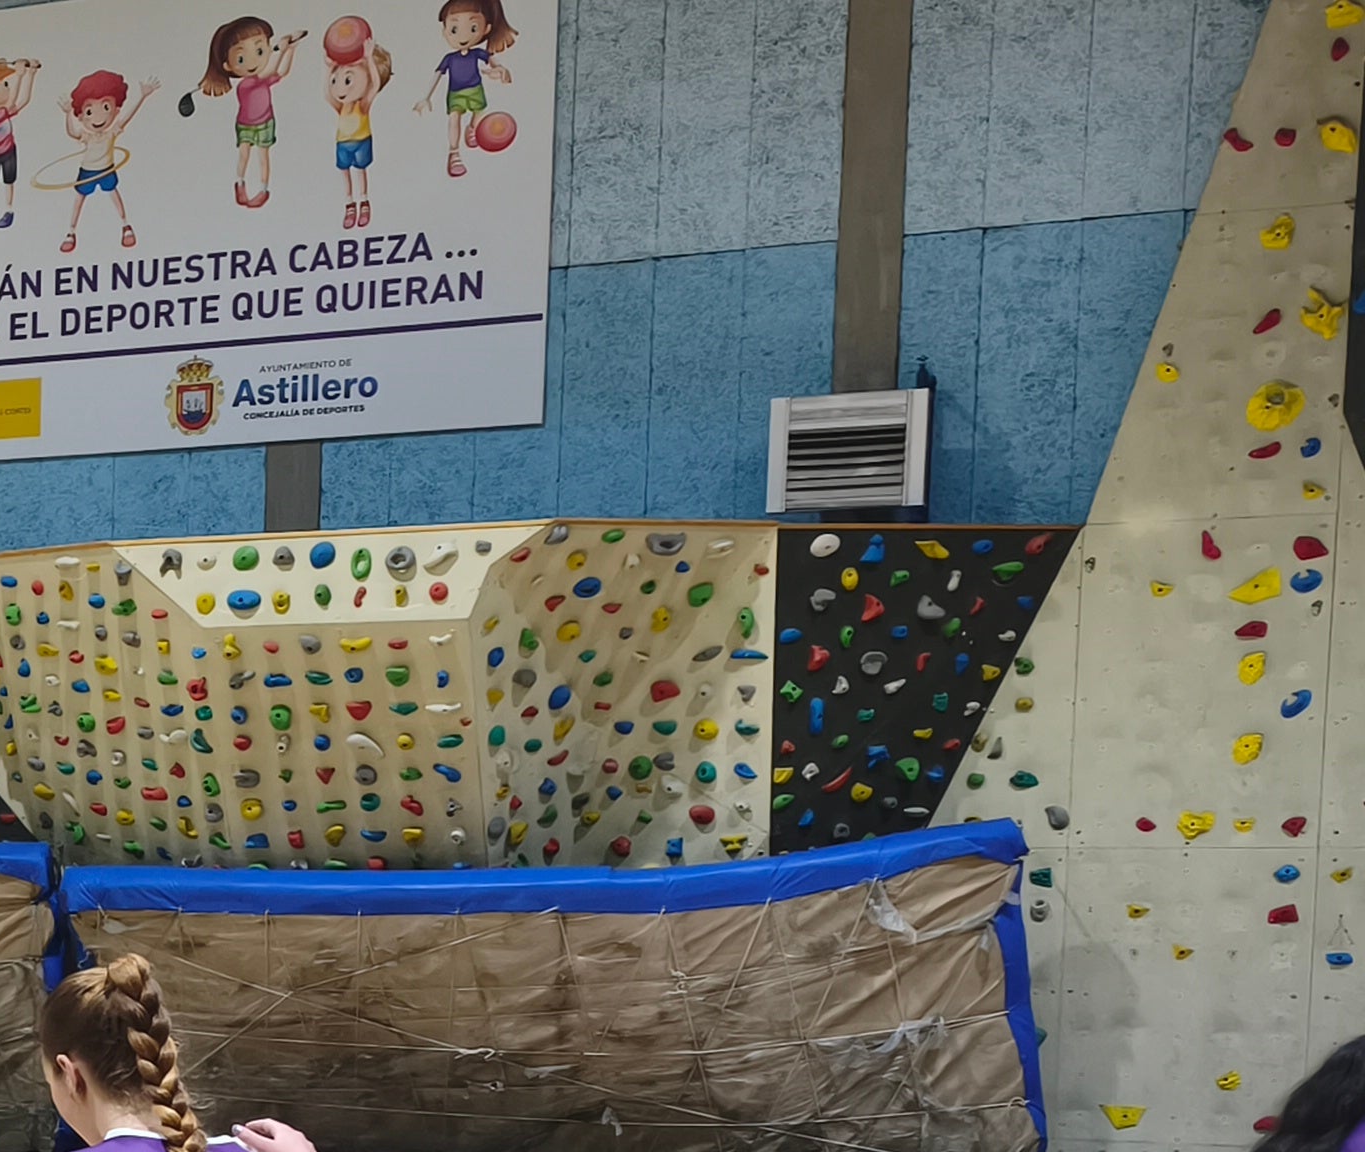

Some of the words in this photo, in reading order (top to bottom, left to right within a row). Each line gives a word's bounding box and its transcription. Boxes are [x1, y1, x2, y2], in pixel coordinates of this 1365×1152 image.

[54, 264, 100, 297] EN
[110, 247, 278, 292] NUESTRA
[287, 232, 434, 274] CABEZA
[8, 310, 50, 343] EL
[59, 294, 221, 337] DEPORTE
[230, 286, 305, 321] QUE
[315, 269, 485, 314] QUIERAN
[258, 359, 337, 374] AYUNTAMIENTO
[338, 358, 353, 368] DE
[231, 373, 380, 408] Astillero
[301, 407, 316, 417] DE
[316, 404, 366, 416] DEPORTES
